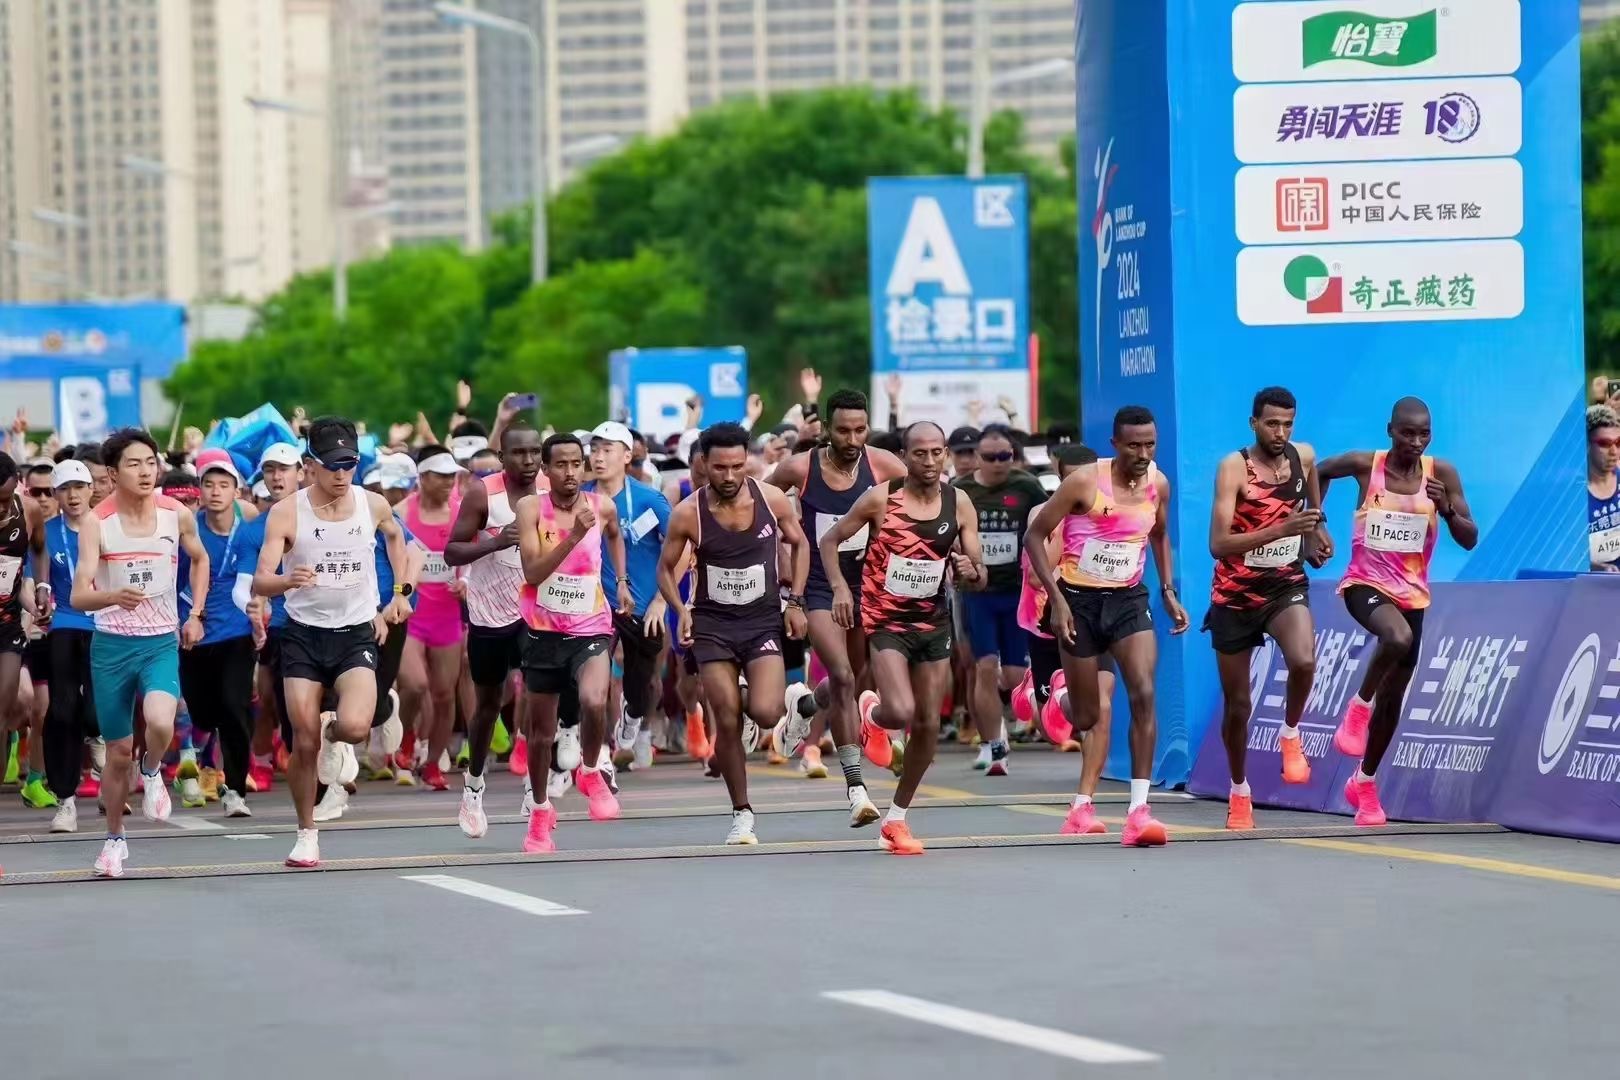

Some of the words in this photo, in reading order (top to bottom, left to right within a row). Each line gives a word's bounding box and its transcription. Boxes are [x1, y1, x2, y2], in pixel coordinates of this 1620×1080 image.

[1331, 21, 1408, 57] 怡寶
[1276, 102, 1404, 143] 勇闯天涯
[1341, 181, 1401, 201] PICC
[1115, 207, 1127, 223] BANK
[1127, 204, 1134, 221] OF
[1341, 202, 1482, 224] 中国人民保险
[1115, 224, 1136, 243] LANZHOU
[1136, 221, 1147, 239] CUP
[885, 196, 973, 295] A
[1116, 252, 1141, 300] 2024
[1349, 273, 1477, 311] 奇正藏药
[1118, 306, 1149, 339] LANZHOU
[1120, 345, 1156, 378] MARATHON
[1370, 523, 1381, 538] 11
[1383, 528, 1409, 542] PACE
[1093, 553, 1130, 567] Afewerk
[1266, 544, 1291, 558] PACE
[315, 562, 361, 574] 桑吉东知
[334, 573, 342, 581] 17
[892, 570, 939, 584] Andualem
[548, 586, 586, 600] Demeke
[716, 579, 756, 591] Ashenafi
[560, 598, 571, 606] 09
[1408, 634, 1529, 728] 兰州银行
[1247, 725, 1276, 751] BANK
[1391, 741, 1421, 768] BANK
[1420, 743, 1437, 769] OF
[1436, 745, 1492, 773] LANZHOU
[1566, 750, 1601, 780] BANK
[1600, 751, 1616, 782] OF
